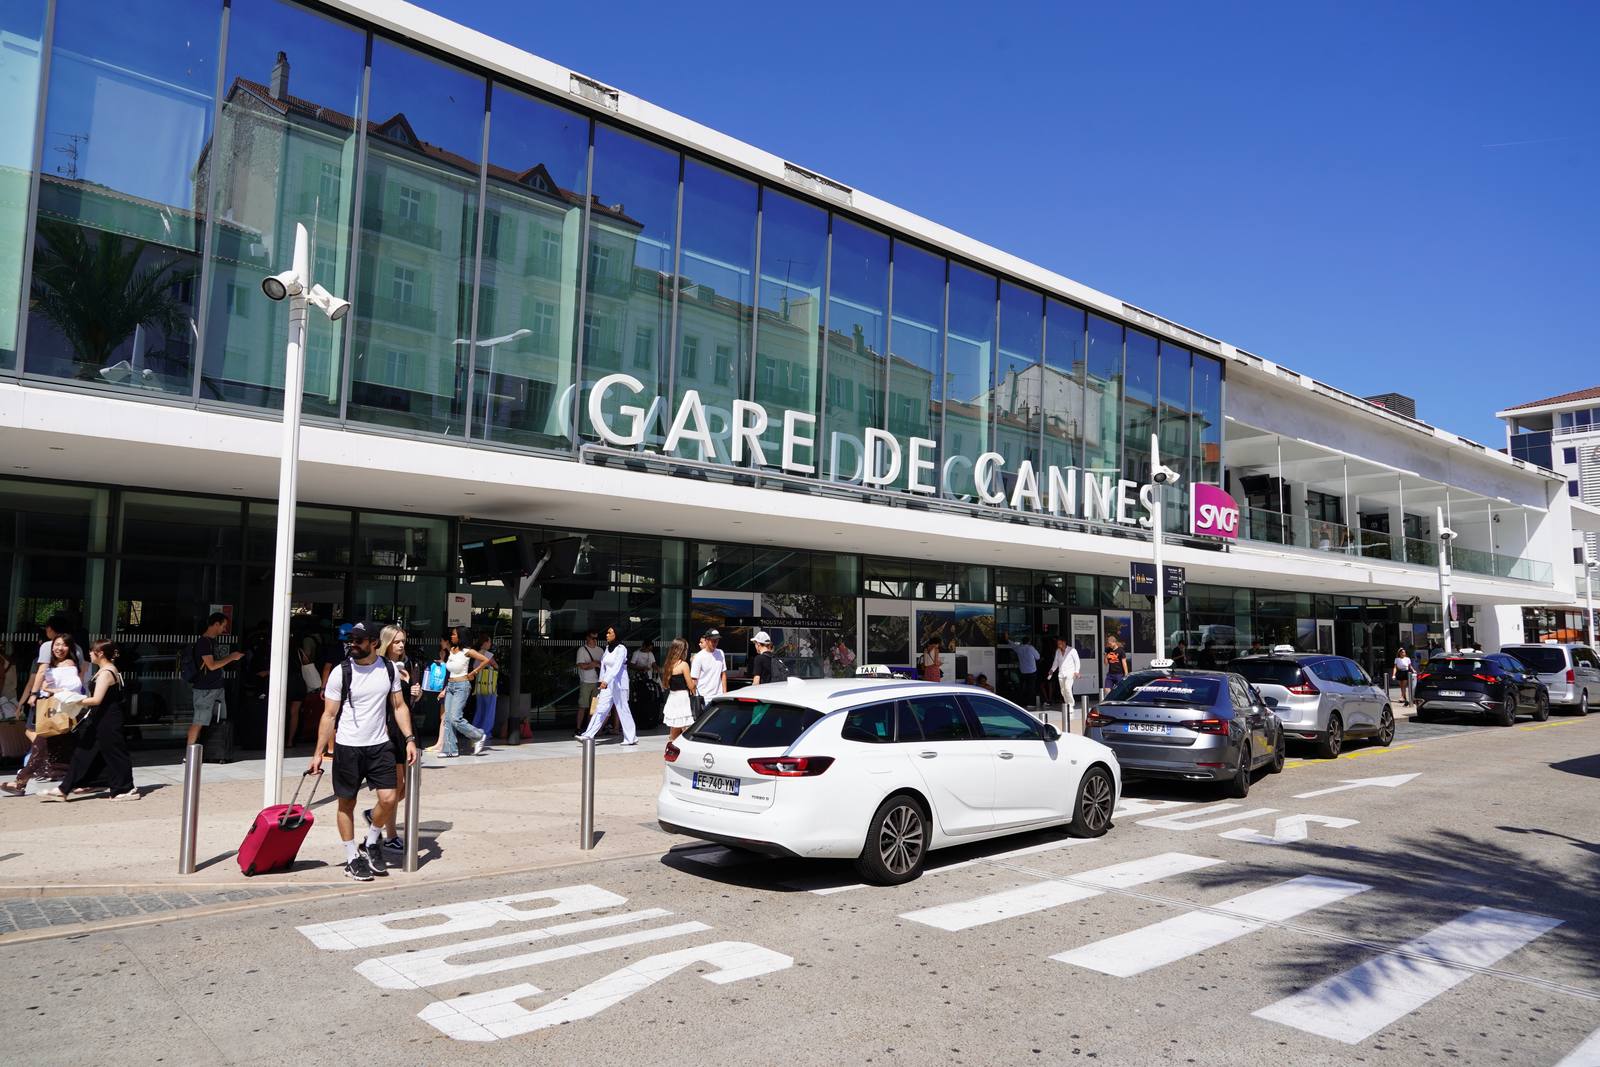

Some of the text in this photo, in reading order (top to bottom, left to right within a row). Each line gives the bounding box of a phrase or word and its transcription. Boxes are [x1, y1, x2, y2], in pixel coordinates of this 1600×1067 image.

[588, 373, 1153, 528] GARE DE CANNES
[1196, 504, 1239, 532] SNCF
[860, 666, 878, 674] TAXI
[697, 774, 735, 792] FE-740-YN
[294, 884, 795, 1042] BUS
